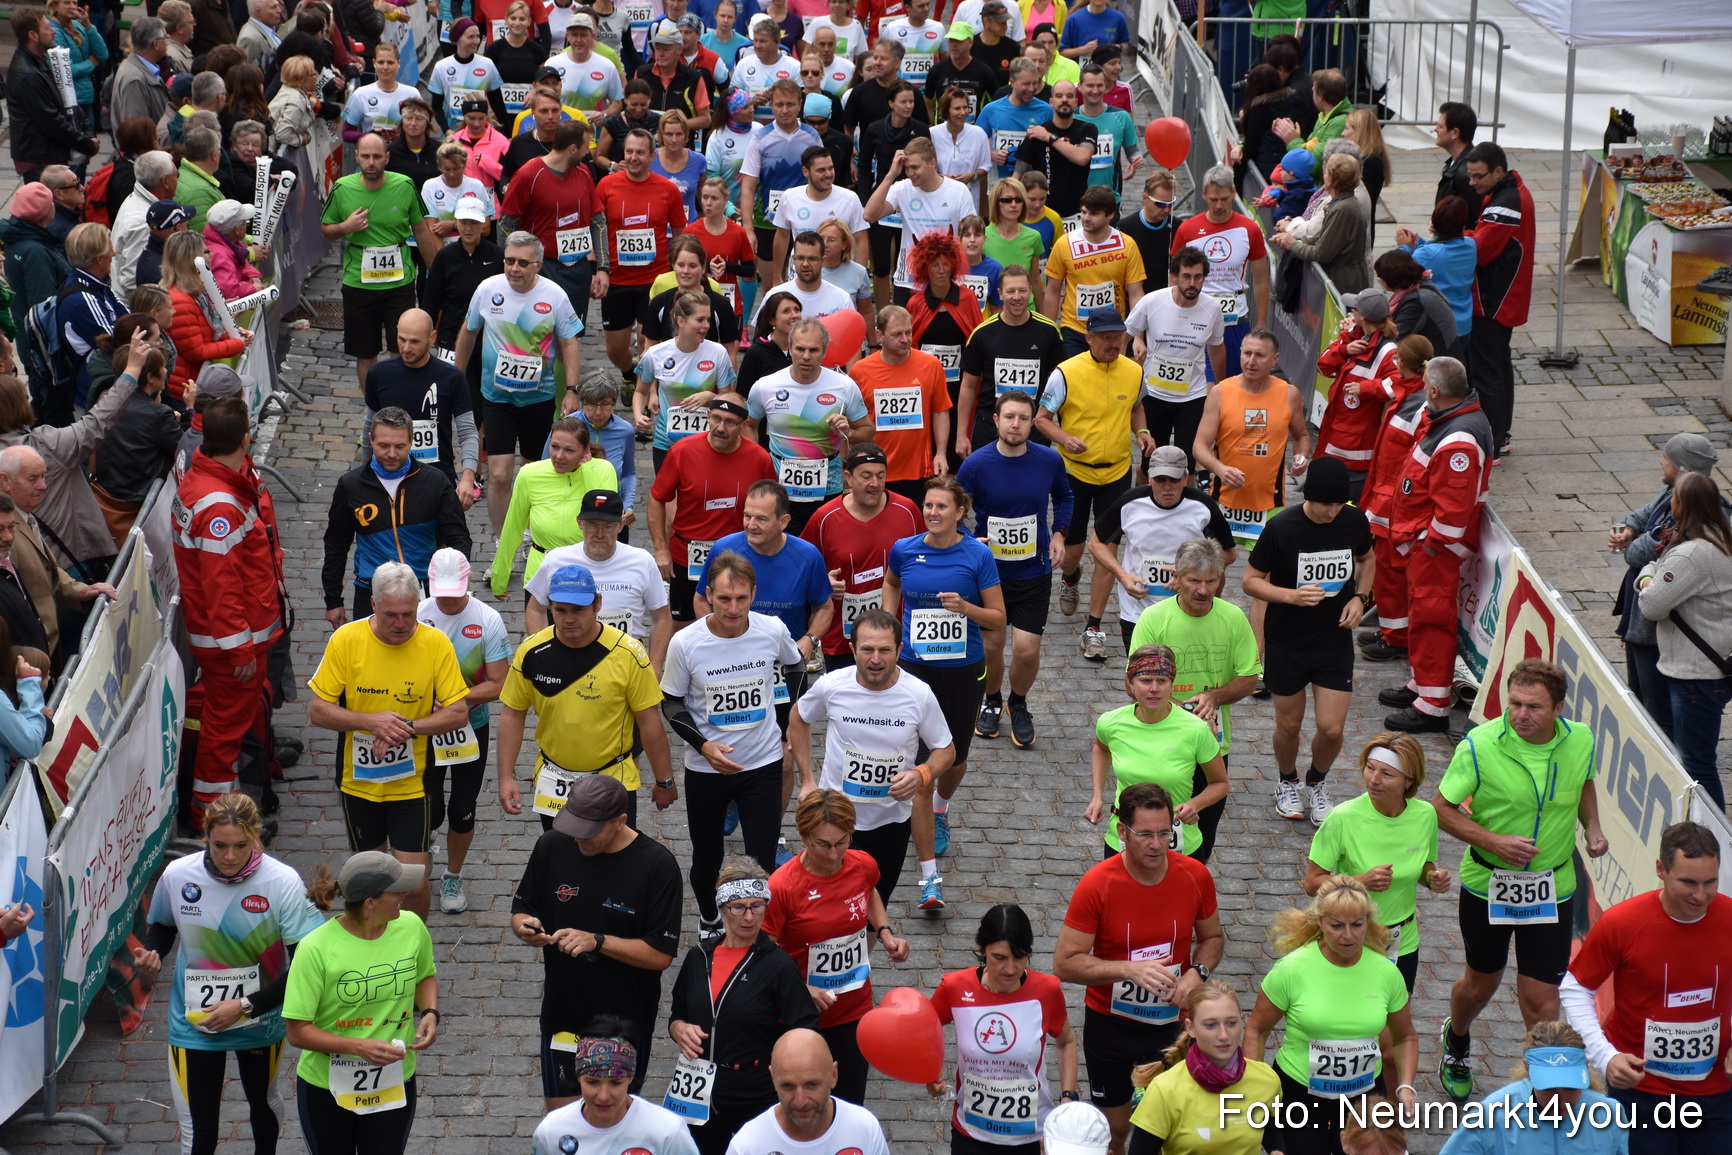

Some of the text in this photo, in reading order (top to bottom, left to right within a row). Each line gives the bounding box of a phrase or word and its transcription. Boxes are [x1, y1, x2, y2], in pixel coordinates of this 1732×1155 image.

[626, 9, 651, 21] 2667
[905, 60, 931, 72] 2756
[252, 163, 267, 237] BMW Laufsport
[272, 192, 287, 211] BMW
[561, 234, 590, 254] 2473
[619, 238, 652, 253] 2634
[370, 255, 396, 269] 144
[1074, 251, 1127, 270] MAX BÖGL
[370, 270, 395, 278] Christian
[1080, 290, 1112, 307] 2782
[498, 353, 536, 366] PARTL Neumarkt
[499, 361, 538, 381] 2477
[999, 368, 1036, 385] 2412
[1157, 363, 1185, 382] 532
[506, 381, 528, 390] Gerald
[879, 397, 918, 415] 2827
[672, 415, 709, 432] 2147
[889, 417, 909, 425] Stefan
[784, 468, 822, 486] 2661
[792, 488, 813, 497] Martin
[1224, 508, 1262, 523] 3090
[997, 527, 1029, 545] 356
[1001, 547, 1026, 556] Markus
[1303, 562, 1347, 582] 3005
[859, 593, 883, 603] Neumark
[916, 620, 963, 642] 2306
[926, 644, 952, 654] Andrea
[706, 659, 766, 677] www.hasit.de
[534, 674, 562, 685] Jürgen
[356, 686, 389, 695] Norbert
[706, 680, 756, 693] PARTL Neumarkt
[712, 688, 762, 713] 2506
[725, 713, 751, 724] Hubert
[842, 715, 906, 728] www.hasit.de
[353, 736, 368, 744] PARTL
[445, 749, 460, 758] Eva
[845, 750, 896, 763] PARTL Neumarkt
[847, 760, 899, 784] 2595
[859, 786, 882, 797] Peter
[1492, 872, 1512, 881] PARTL
[1495, 880, 1550, 905] 2350
[180, 905, 202, 913] PARTL
[245, 899, 267, 909] Hervis
[1504, 906, 1541, 918] Manfred
[811, 942, 834, 951] PARTL
[815, 943, 863, 974] 2091
[1142, 948, 1161, 959] DEHN
[211, 974, 247, 982] Neumarkt
[336, 955, 417, 1004] OPF
[1680, 993, 1702, 1003] DEHN
[1133, 1007, 1161, 1018] Oliver
[335, 1017, 374, 1028] MERZ
[1647, 1024, 1711, 1036] PARTL Neumarkt
[1311, 1044, 1370, 1053] PARTL Neumarkt
[1653, 1034, 1714, 1060] 3333
[331, 1059, 357, 1068] PARTL
[678, 1060, 704, 1073] Neumarkt
[963, 1055, 989, 1066] LAUFEN
[1008, 1060, 1029, 1070] HERZ
[1316, 1054, 1376, 1078] 2517
[1654, 1061, 1696, 1074] Philipp
[353, 1067, 383, 1092] 27
[966, 1078, 987, 1091] PARTL
[990, 1084, 1026, 1093] Neumarkt
[1323, 1079, 1365, 1092] Elisabeth
[355, 1094, 380, 1106] Petra
[970, 1089, 1032, 1119] 2728
[668, 1099, 687, 1116] Karin
[986, 1121, 1012, 1134] Doris
